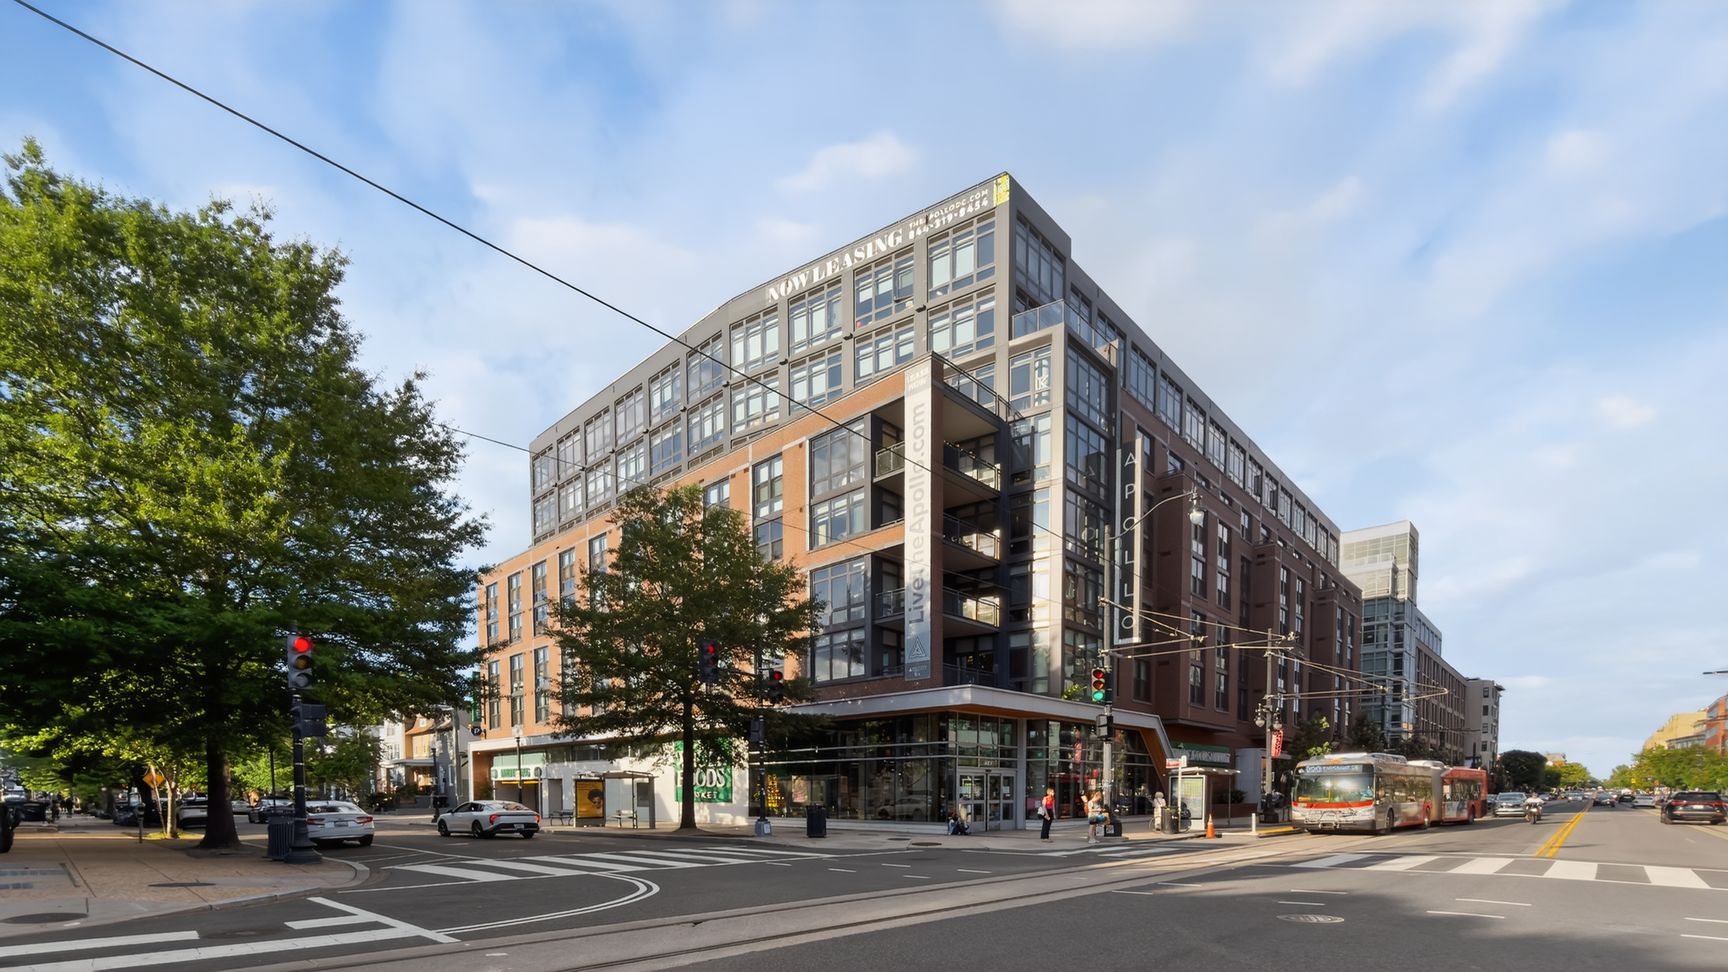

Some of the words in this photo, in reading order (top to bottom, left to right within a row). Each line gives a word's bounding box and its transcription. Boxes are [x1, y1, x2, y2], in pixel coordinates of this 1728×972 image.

[768, 270, 810, 303] NOW
[812, 228, 903, 284] LEASING
[1121, 452, 1138, 630] APOLLO
[677, 767, 725, 788] FODS
